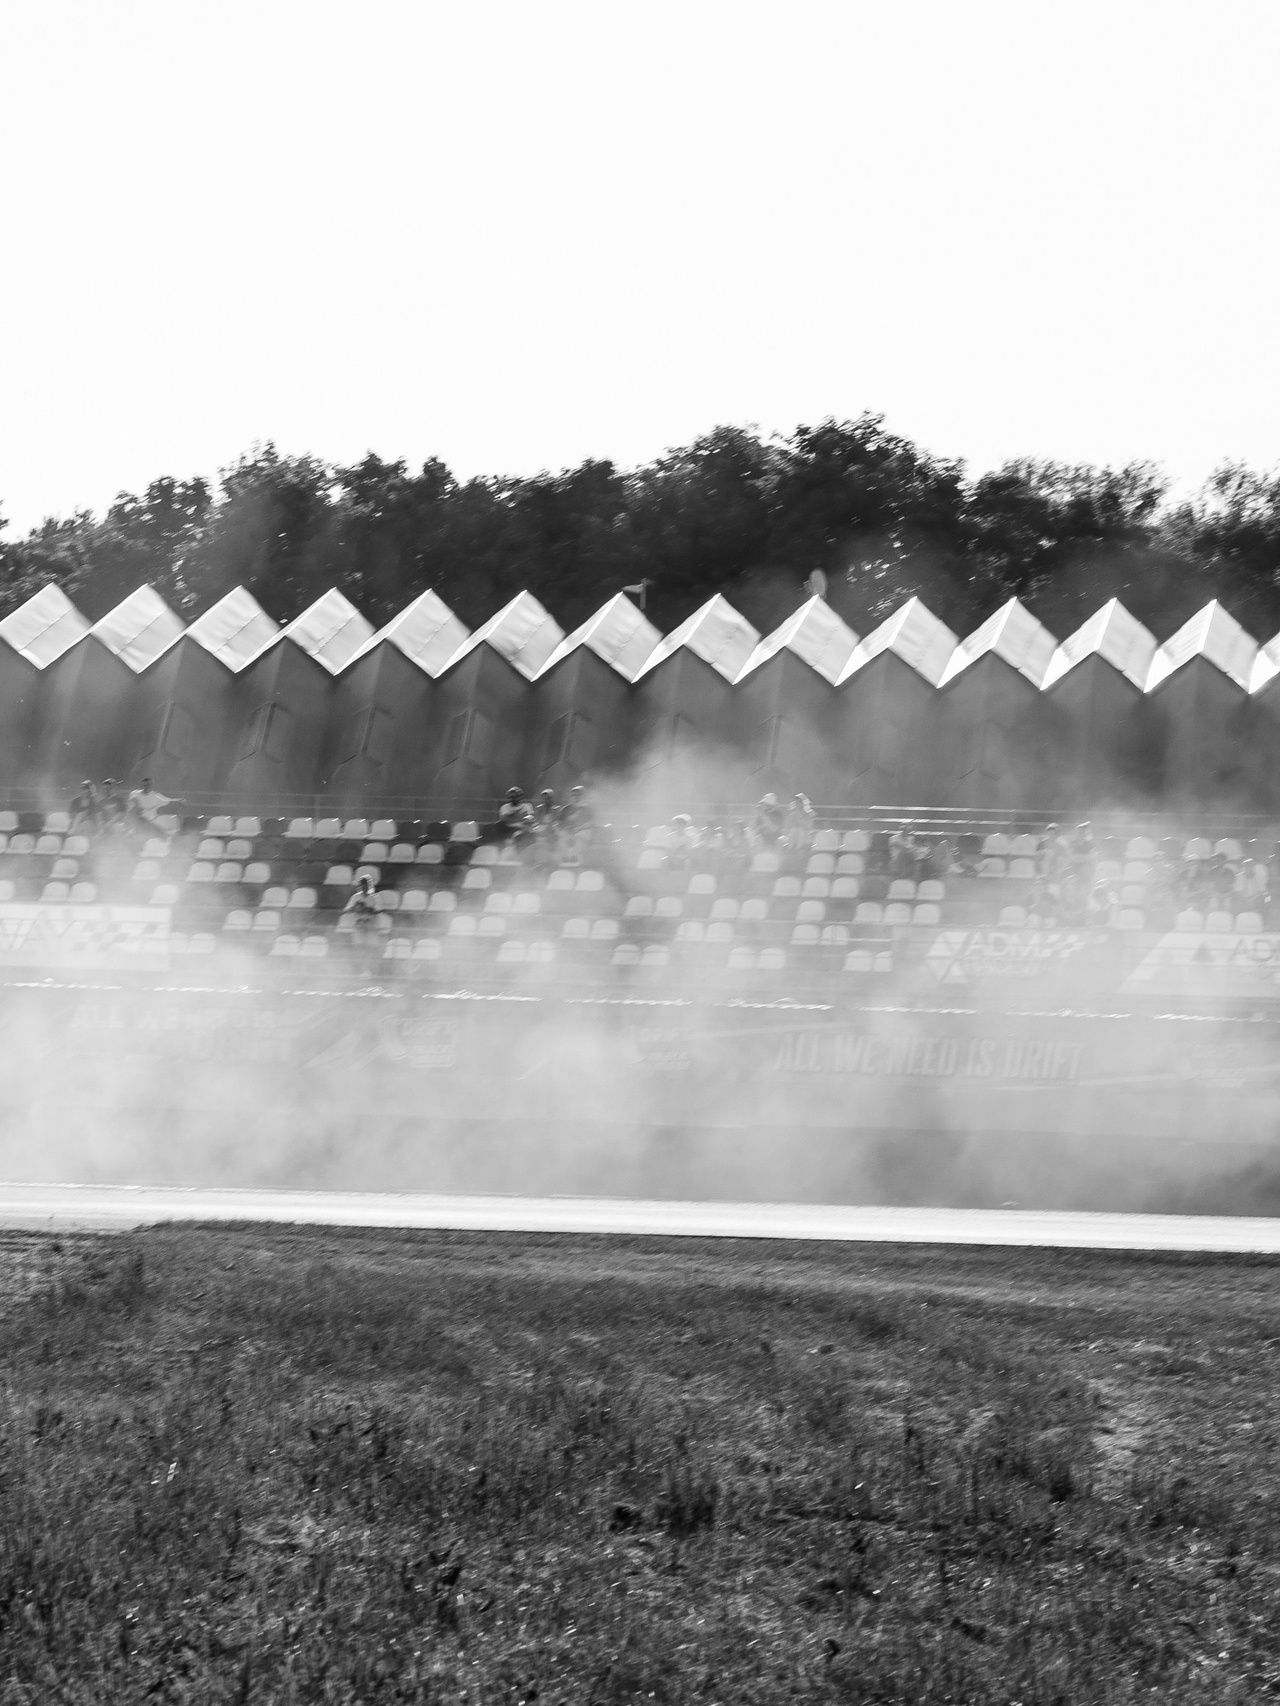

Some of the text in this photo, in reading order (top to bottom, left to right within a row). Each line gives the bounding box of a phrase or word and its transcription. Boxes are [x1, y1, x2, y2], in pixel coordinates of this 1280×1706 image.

[964, 931, 1041, 957] ADM
[772, 1033, 1088, 1080] ALL WE NEED IS DRIFT
